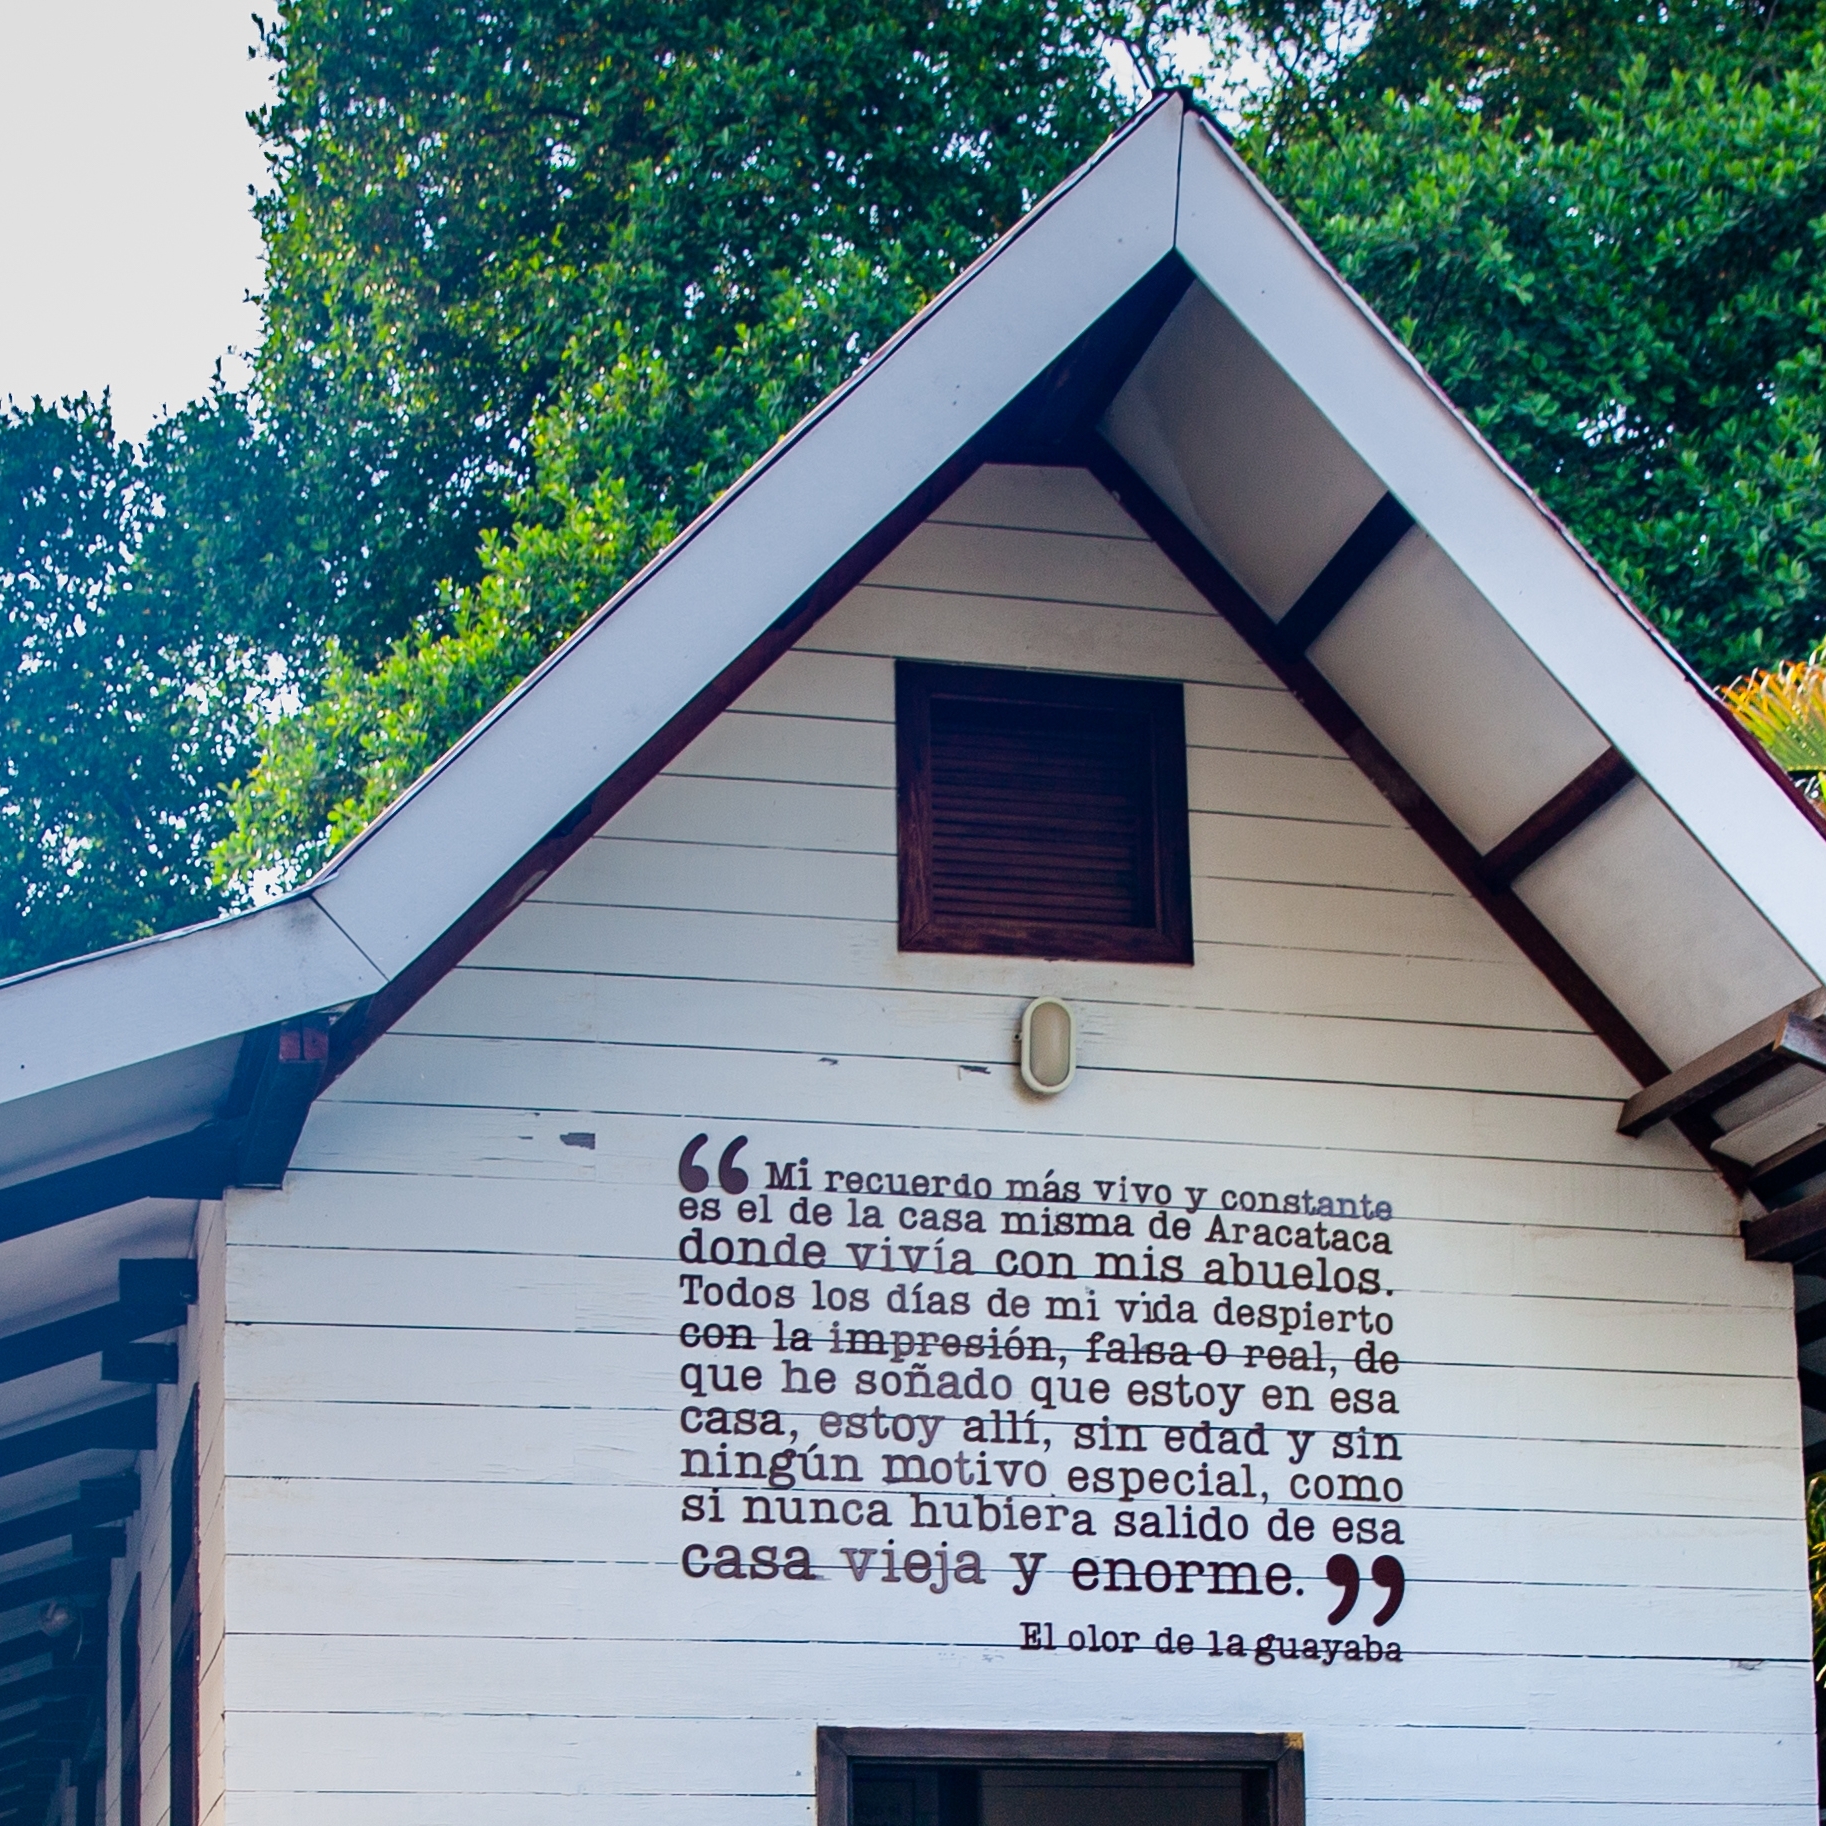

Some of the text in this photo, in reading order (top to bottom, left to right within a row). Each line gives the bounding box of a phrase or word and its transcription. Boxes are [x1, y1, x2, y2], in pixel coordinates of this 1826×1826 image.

[679, 1194, 1393, 1255] es el de la casa misma de Aracataca
[824, 1169, 992, 1199] recuerdo
[1006, 1169, 1080, 1203] más
[1093, 1176, 1172, 1205] vivo
[1185, 1186, 1208, 1213] y
[1221, 1188, 1394, 1221] constante
[679, 1228, 1394, 1296] donde vivía con mis abuelos.
[679, 1274, 1394, 1336] Todos los días de mi vida despierto
[679, 1321, 756, 1349] con
[773, 1319, 813, 1351] la
[829, 1321, 1067, 1369] impresión,
[1085, 1331, 1191, 1366] falsa
[1244, 1340, 1338, 1378] real,
[1354, 1340, 1399, 1374] de
[679, 1359, 1399, 1417] que he soñado que estoy en esa
[679, 1404, 1403, 1464] casa, estoy allí, sin edad y sin
[679, 1442, 1403, 1504] ningún motivo especial, como
[682, 1487, 1405, 1545] si nunca hubiera salido de esa
[682, 1543, 817, 1581] casa
[839, 1538, 986, 1594] vieja
[1010, 1552, 1047, 1596] y
[1073, 1555, 1304, 1597] enorme.
[1019, 1621, 1404, 1666] El olor de la guayaba
